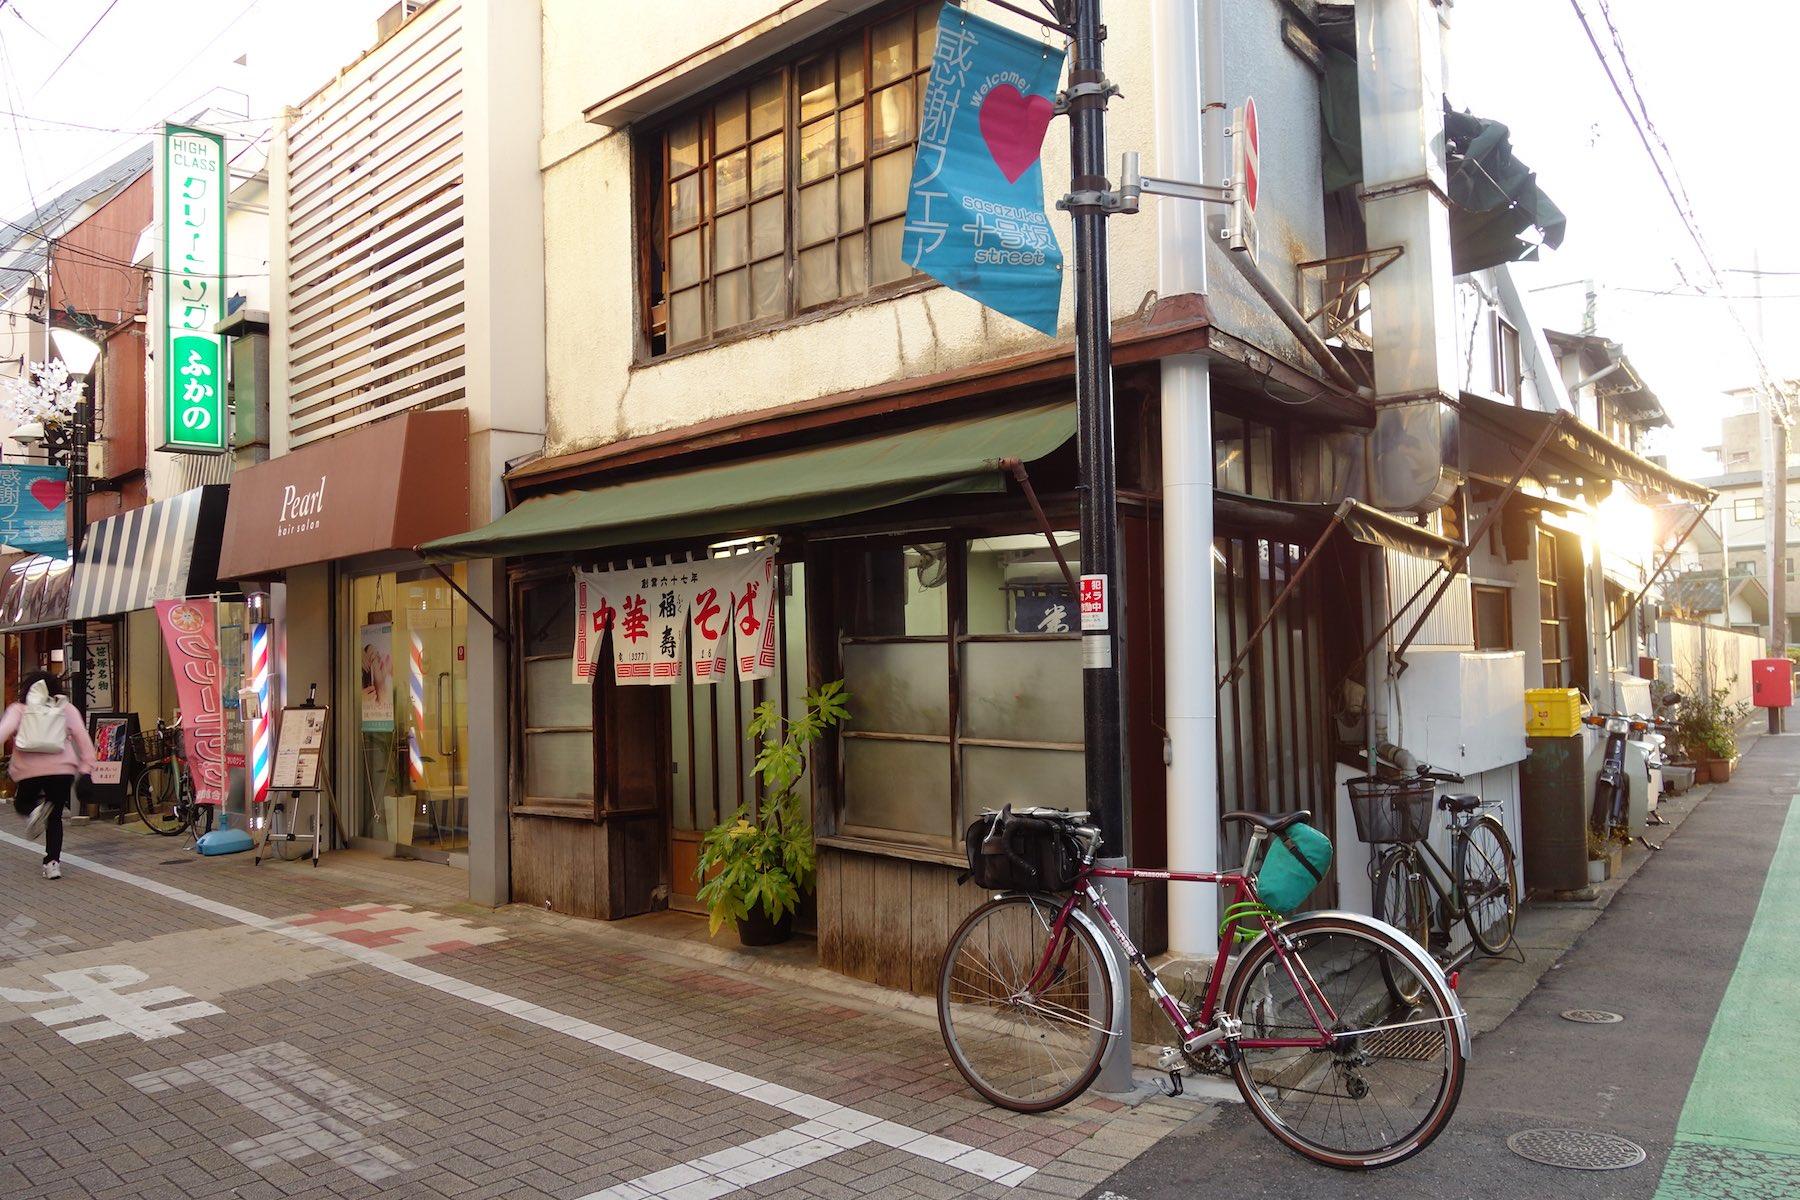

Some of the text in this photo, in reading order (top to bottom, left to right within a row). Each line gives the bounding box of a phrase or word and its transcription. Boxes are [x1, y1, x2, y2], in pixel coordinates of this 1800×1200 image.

[970, 70, 1031, 108] Welcome!
[173, 138, 207, 156] HIGH
[174, 153, 216, 171] CLASS
[962, 195, 1047, 225] sasazuka
[974, 247, 1046, 266] street
[180, 349, 214, 430] ふかの
[279, 475, 327, 522] Pearl
[277, 518, 320, 537] hair salon
[592, 580, 761, 644] 中華 そば
[1133, 869, 1171, 879] Panasonic
